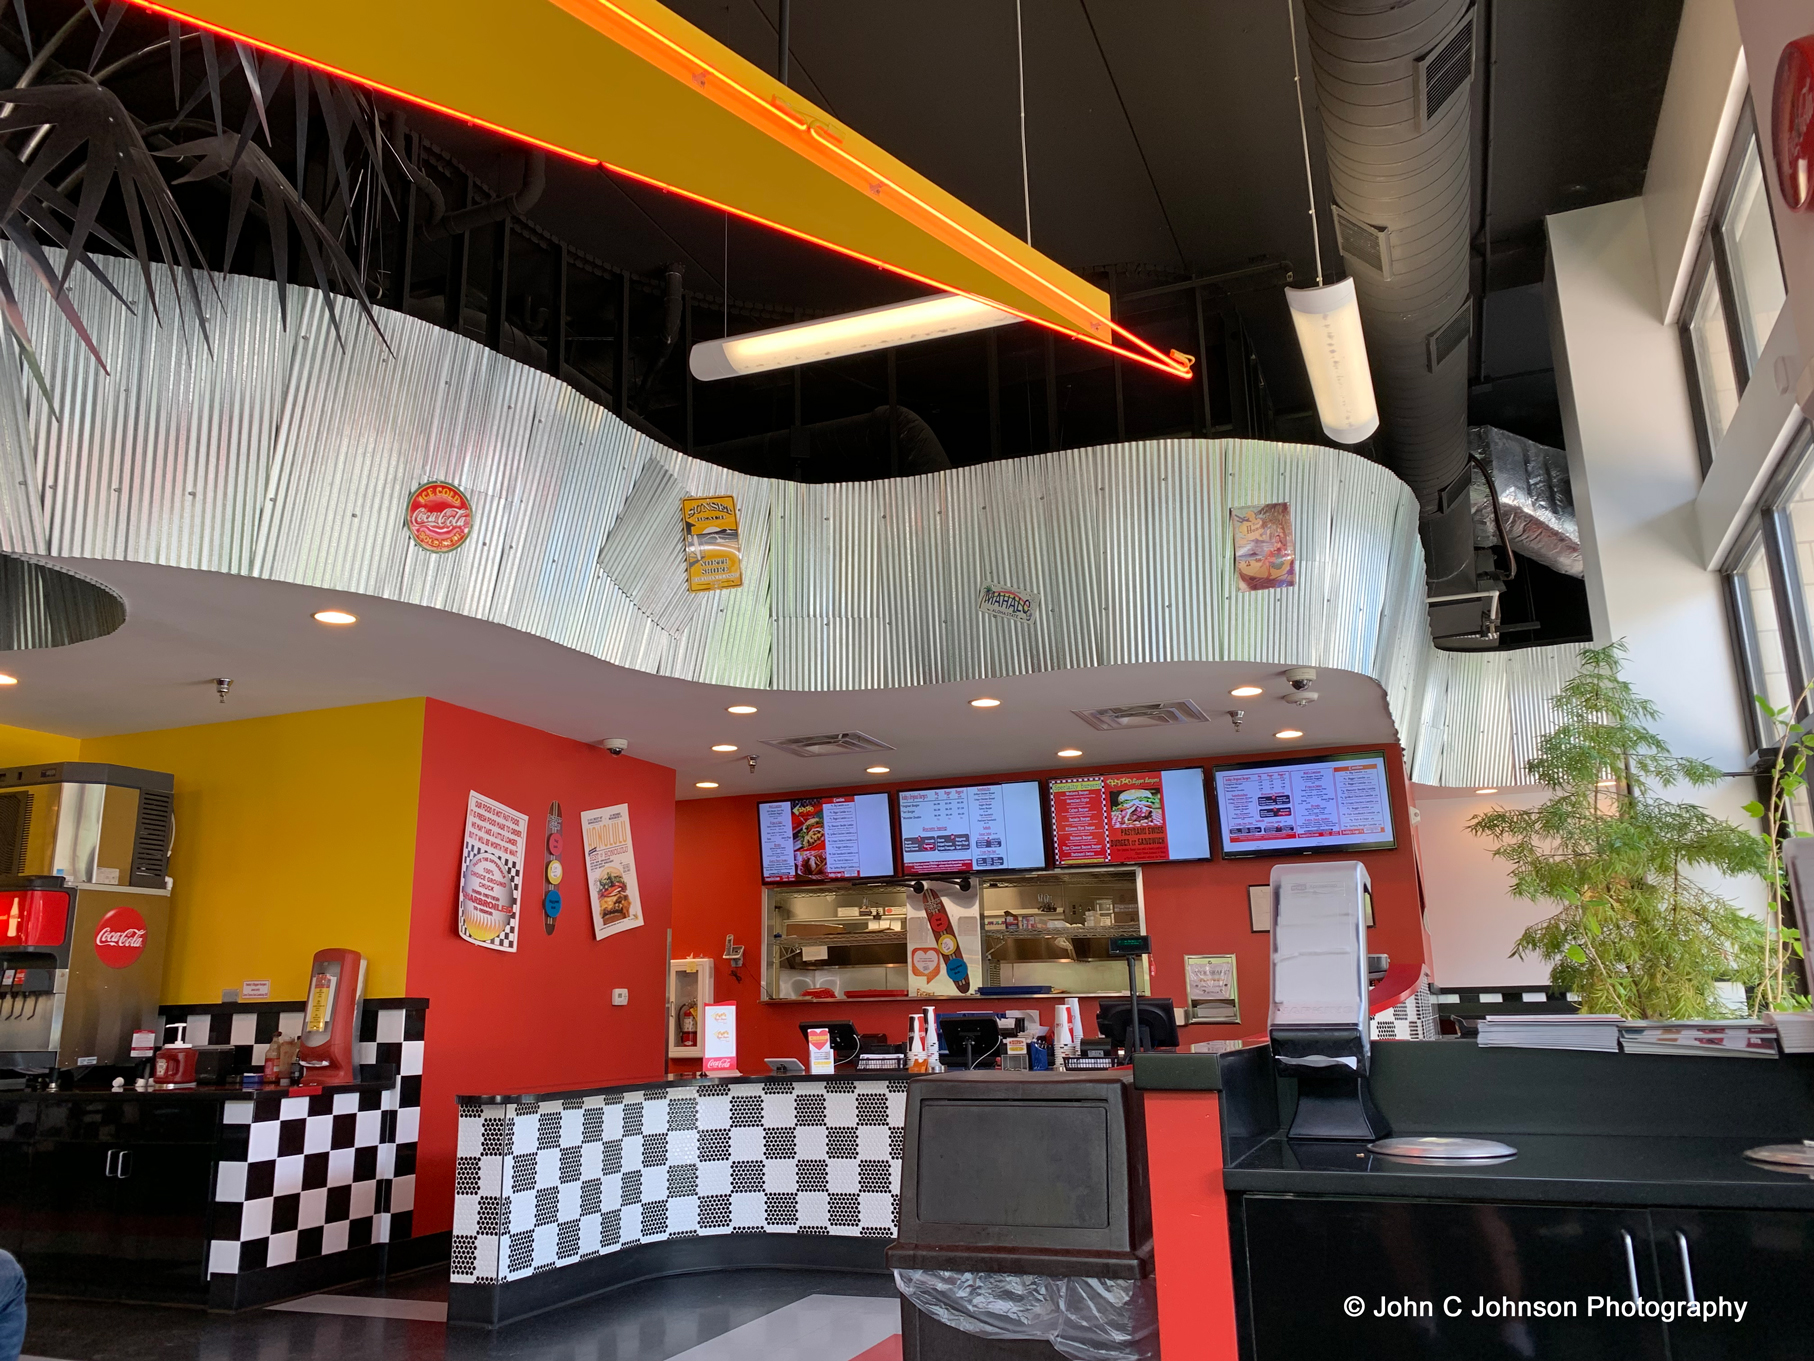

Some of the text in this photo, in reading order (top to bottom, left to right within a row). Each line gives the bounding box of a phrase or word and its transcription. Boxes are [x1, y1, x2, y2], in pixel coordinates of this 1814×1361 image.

[419, 487, 461, 504] ICE COLD
[412, 507, 470, 527] Coca-Cola
[687, 502, 733, 519] SUNSET
[992, 608, 1006, 616] ALOHA
[475, 800, 483, 809] OUR
[482, 803, 492, 814] FOOD
[502, 813, 511, 822] FAST
[477, 812, 487, 823] FRESH
[487, 816, 496, 827] FOOD
[496, 821, 506, 831] MADE
[483, 826, 492, 837] TAKE
[586, 820, 628, 850] HONOLULU
[1120, 828, 1147, 837] PASTRAMI
[470, 869, 507, 888] CHOICE GROUND
[483, 867, 495, 877] 100%
[478, 882, 495, 893] CHUCK
[462, 888, 514, 915] CHARBROILED
[96, 927, 147, 947] Coca-Cola
[707, 1058, 731, 1069] Coca-Cola
